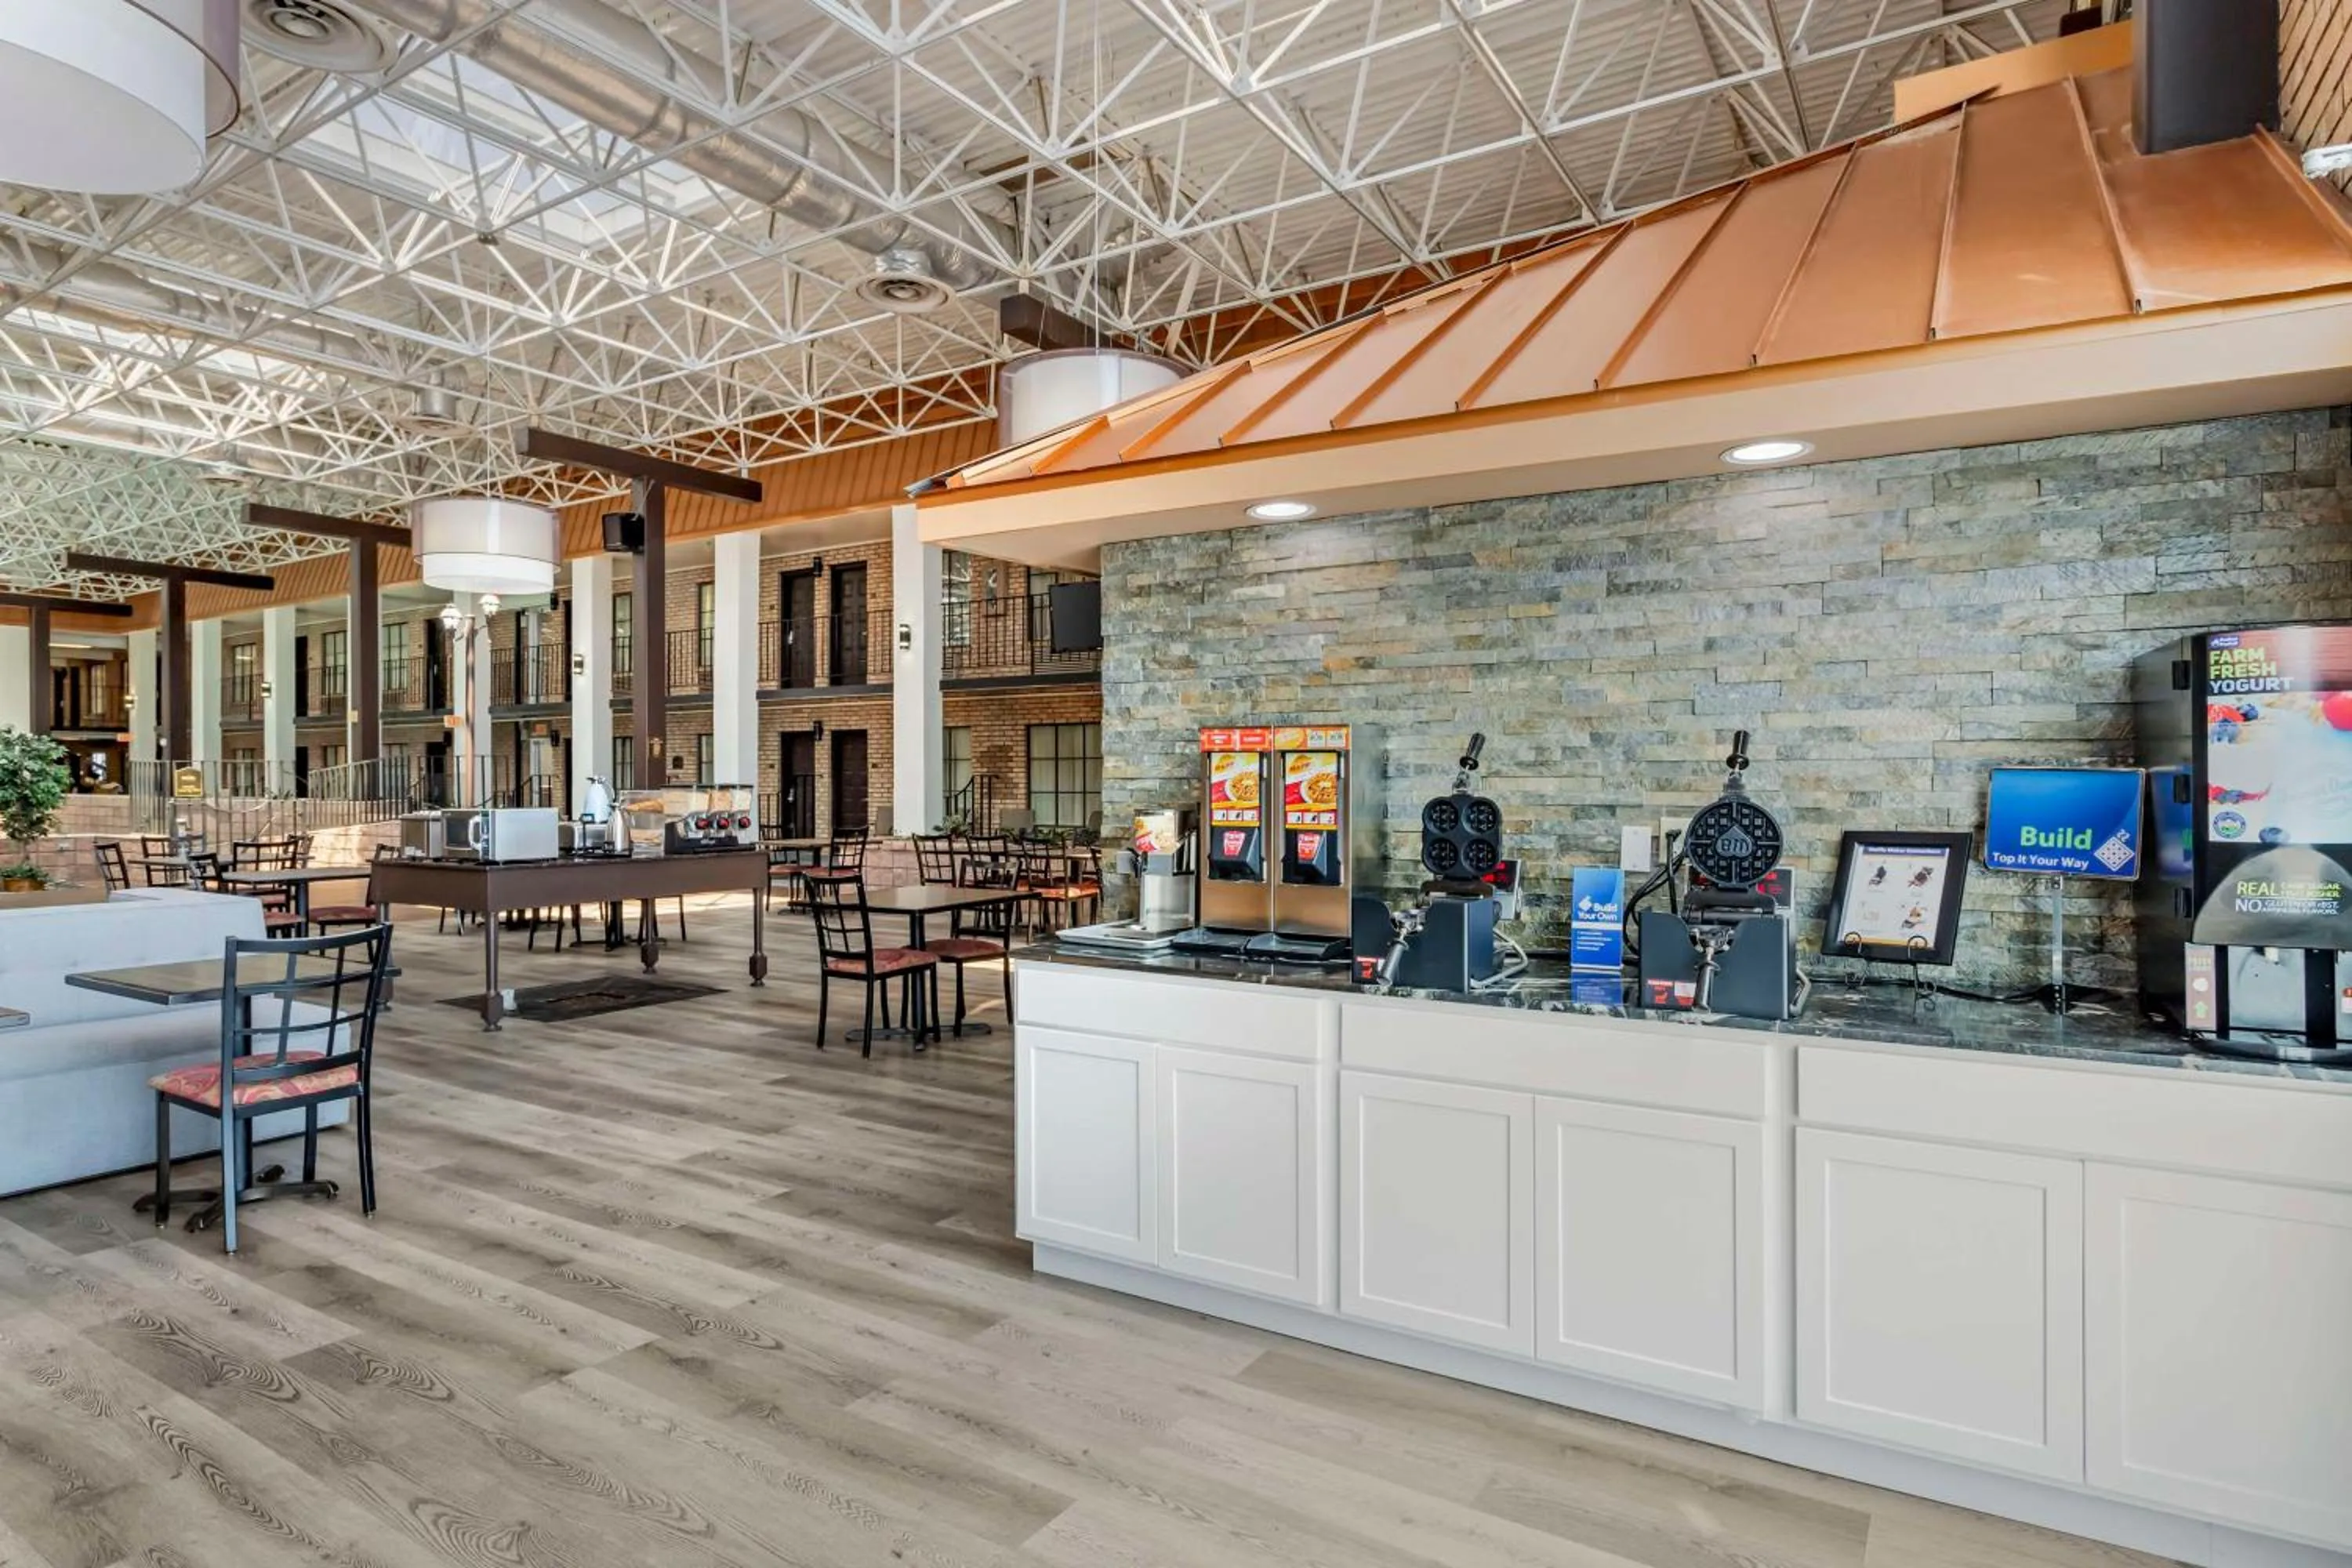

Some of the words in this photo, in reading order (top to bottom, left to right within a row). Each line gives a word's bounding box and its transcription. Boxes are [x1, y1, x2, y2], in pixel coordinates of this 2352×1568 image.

[2209, 647, 2265, 664] FARM
[2210, 662, 2278, 679] FRESH
[2209, 677, 2294, 694] YOGURT
[2020, 826, 2092, 850] Build
[1993, 851, 2014, 864] Top
[2017, 855, 2027, 864] It
[2027, 855, 2059, 866] Your
[2061, 857, 2089, 871] Way
[2237, 880, 2279, 896] REAL
